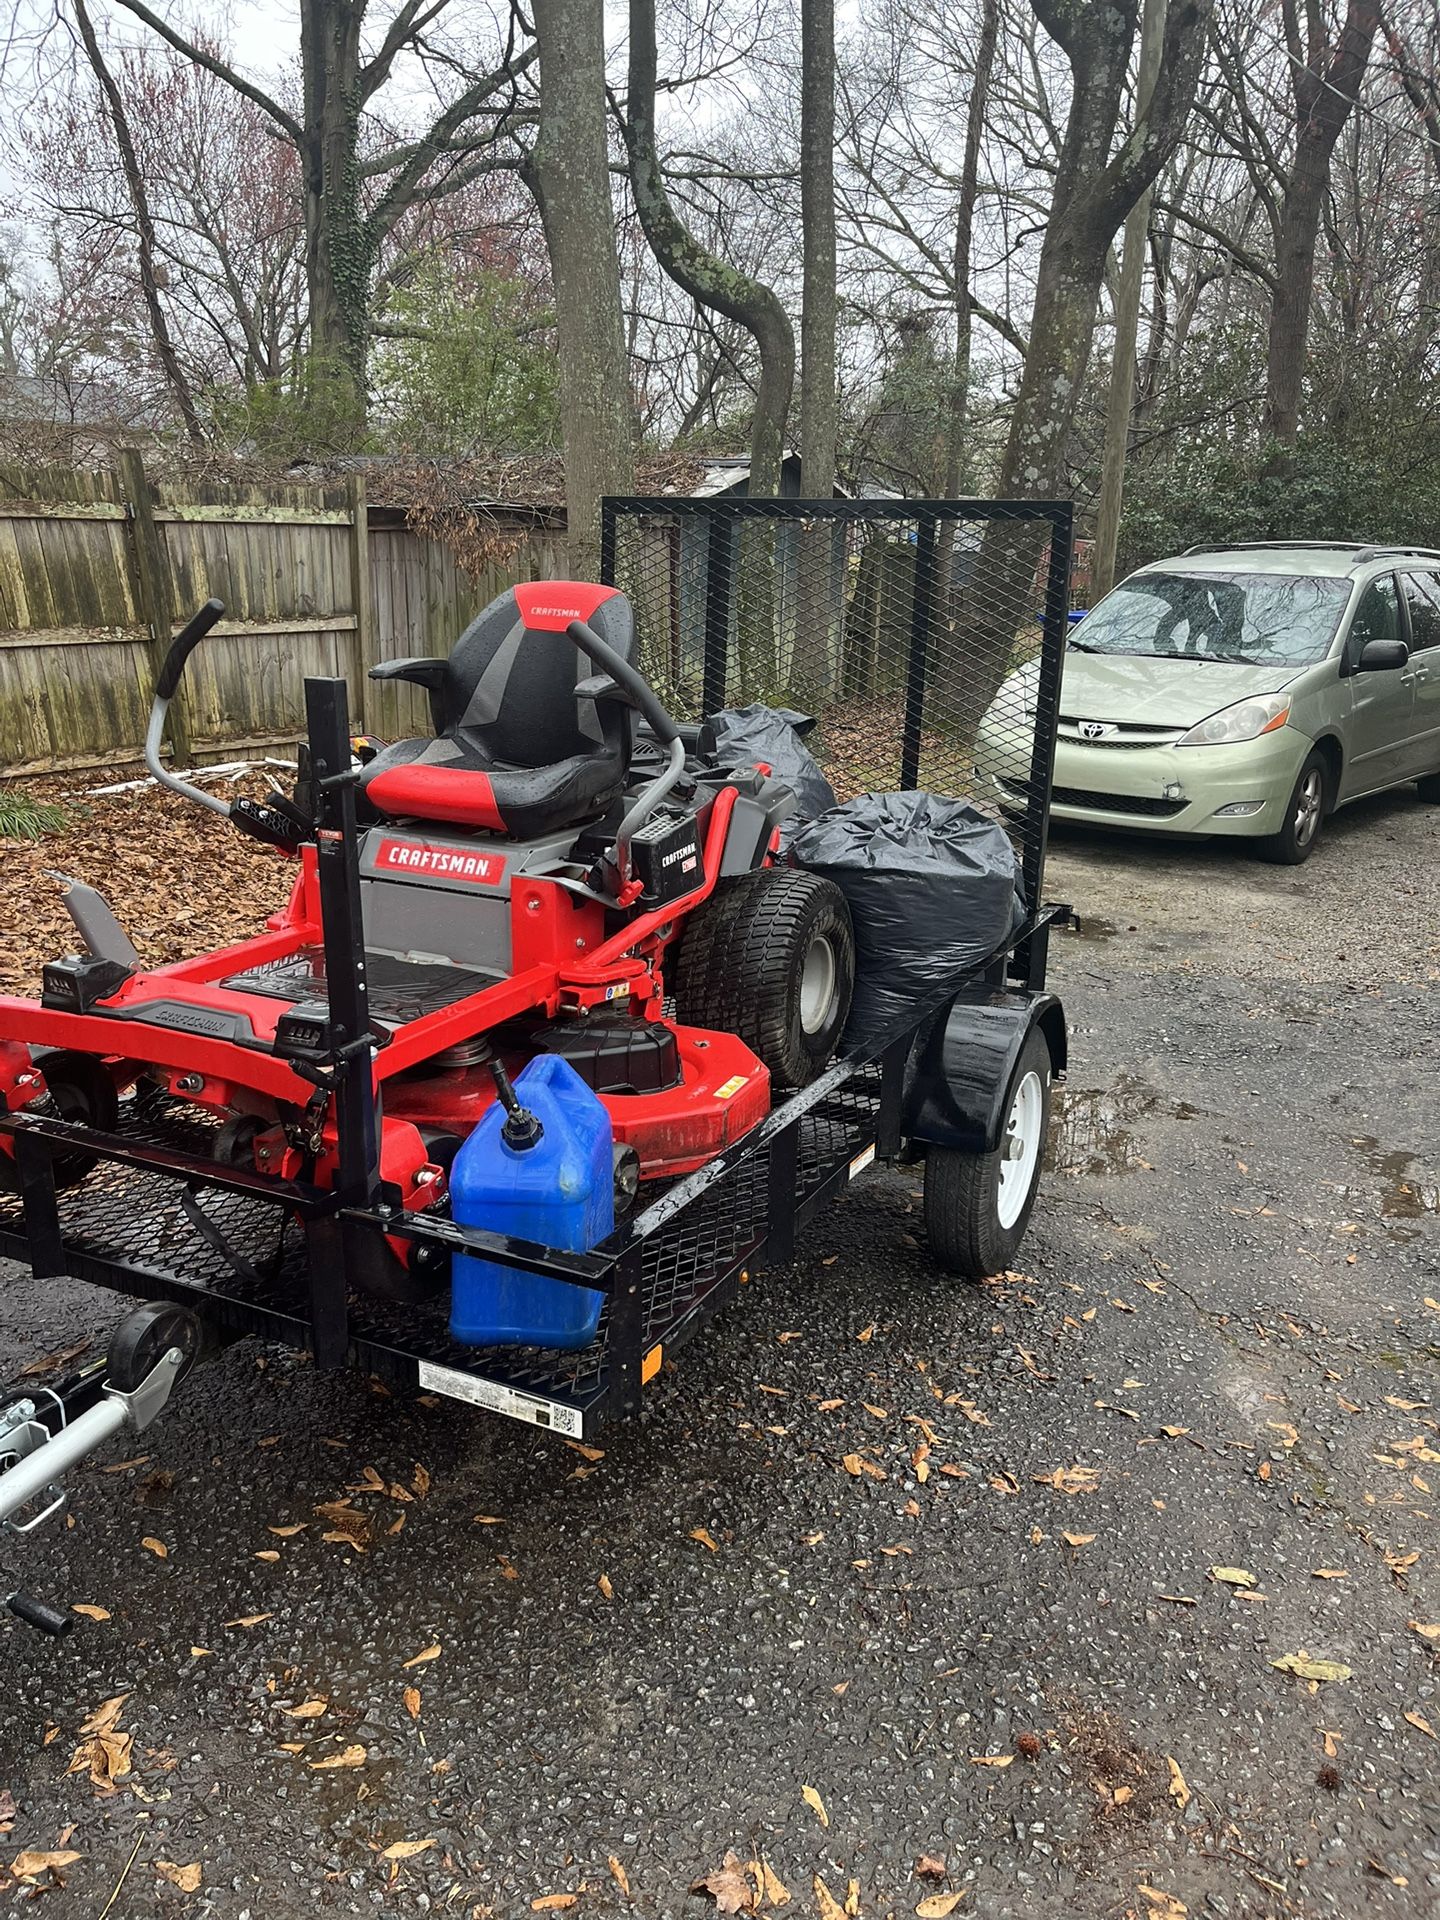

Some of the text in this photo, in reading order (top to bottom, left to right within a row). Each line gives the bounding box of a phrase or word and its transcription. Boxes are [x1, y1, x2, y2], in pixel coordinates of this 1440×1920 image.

[531, 607, 580, 617] CRAFTSMAN
[388, 847, 489, 876] CRAFTSMAN
[662, 842, 696, 868] CRAFTSMAN
[155, 1010, 227, 1032] CRAFTSMAN
